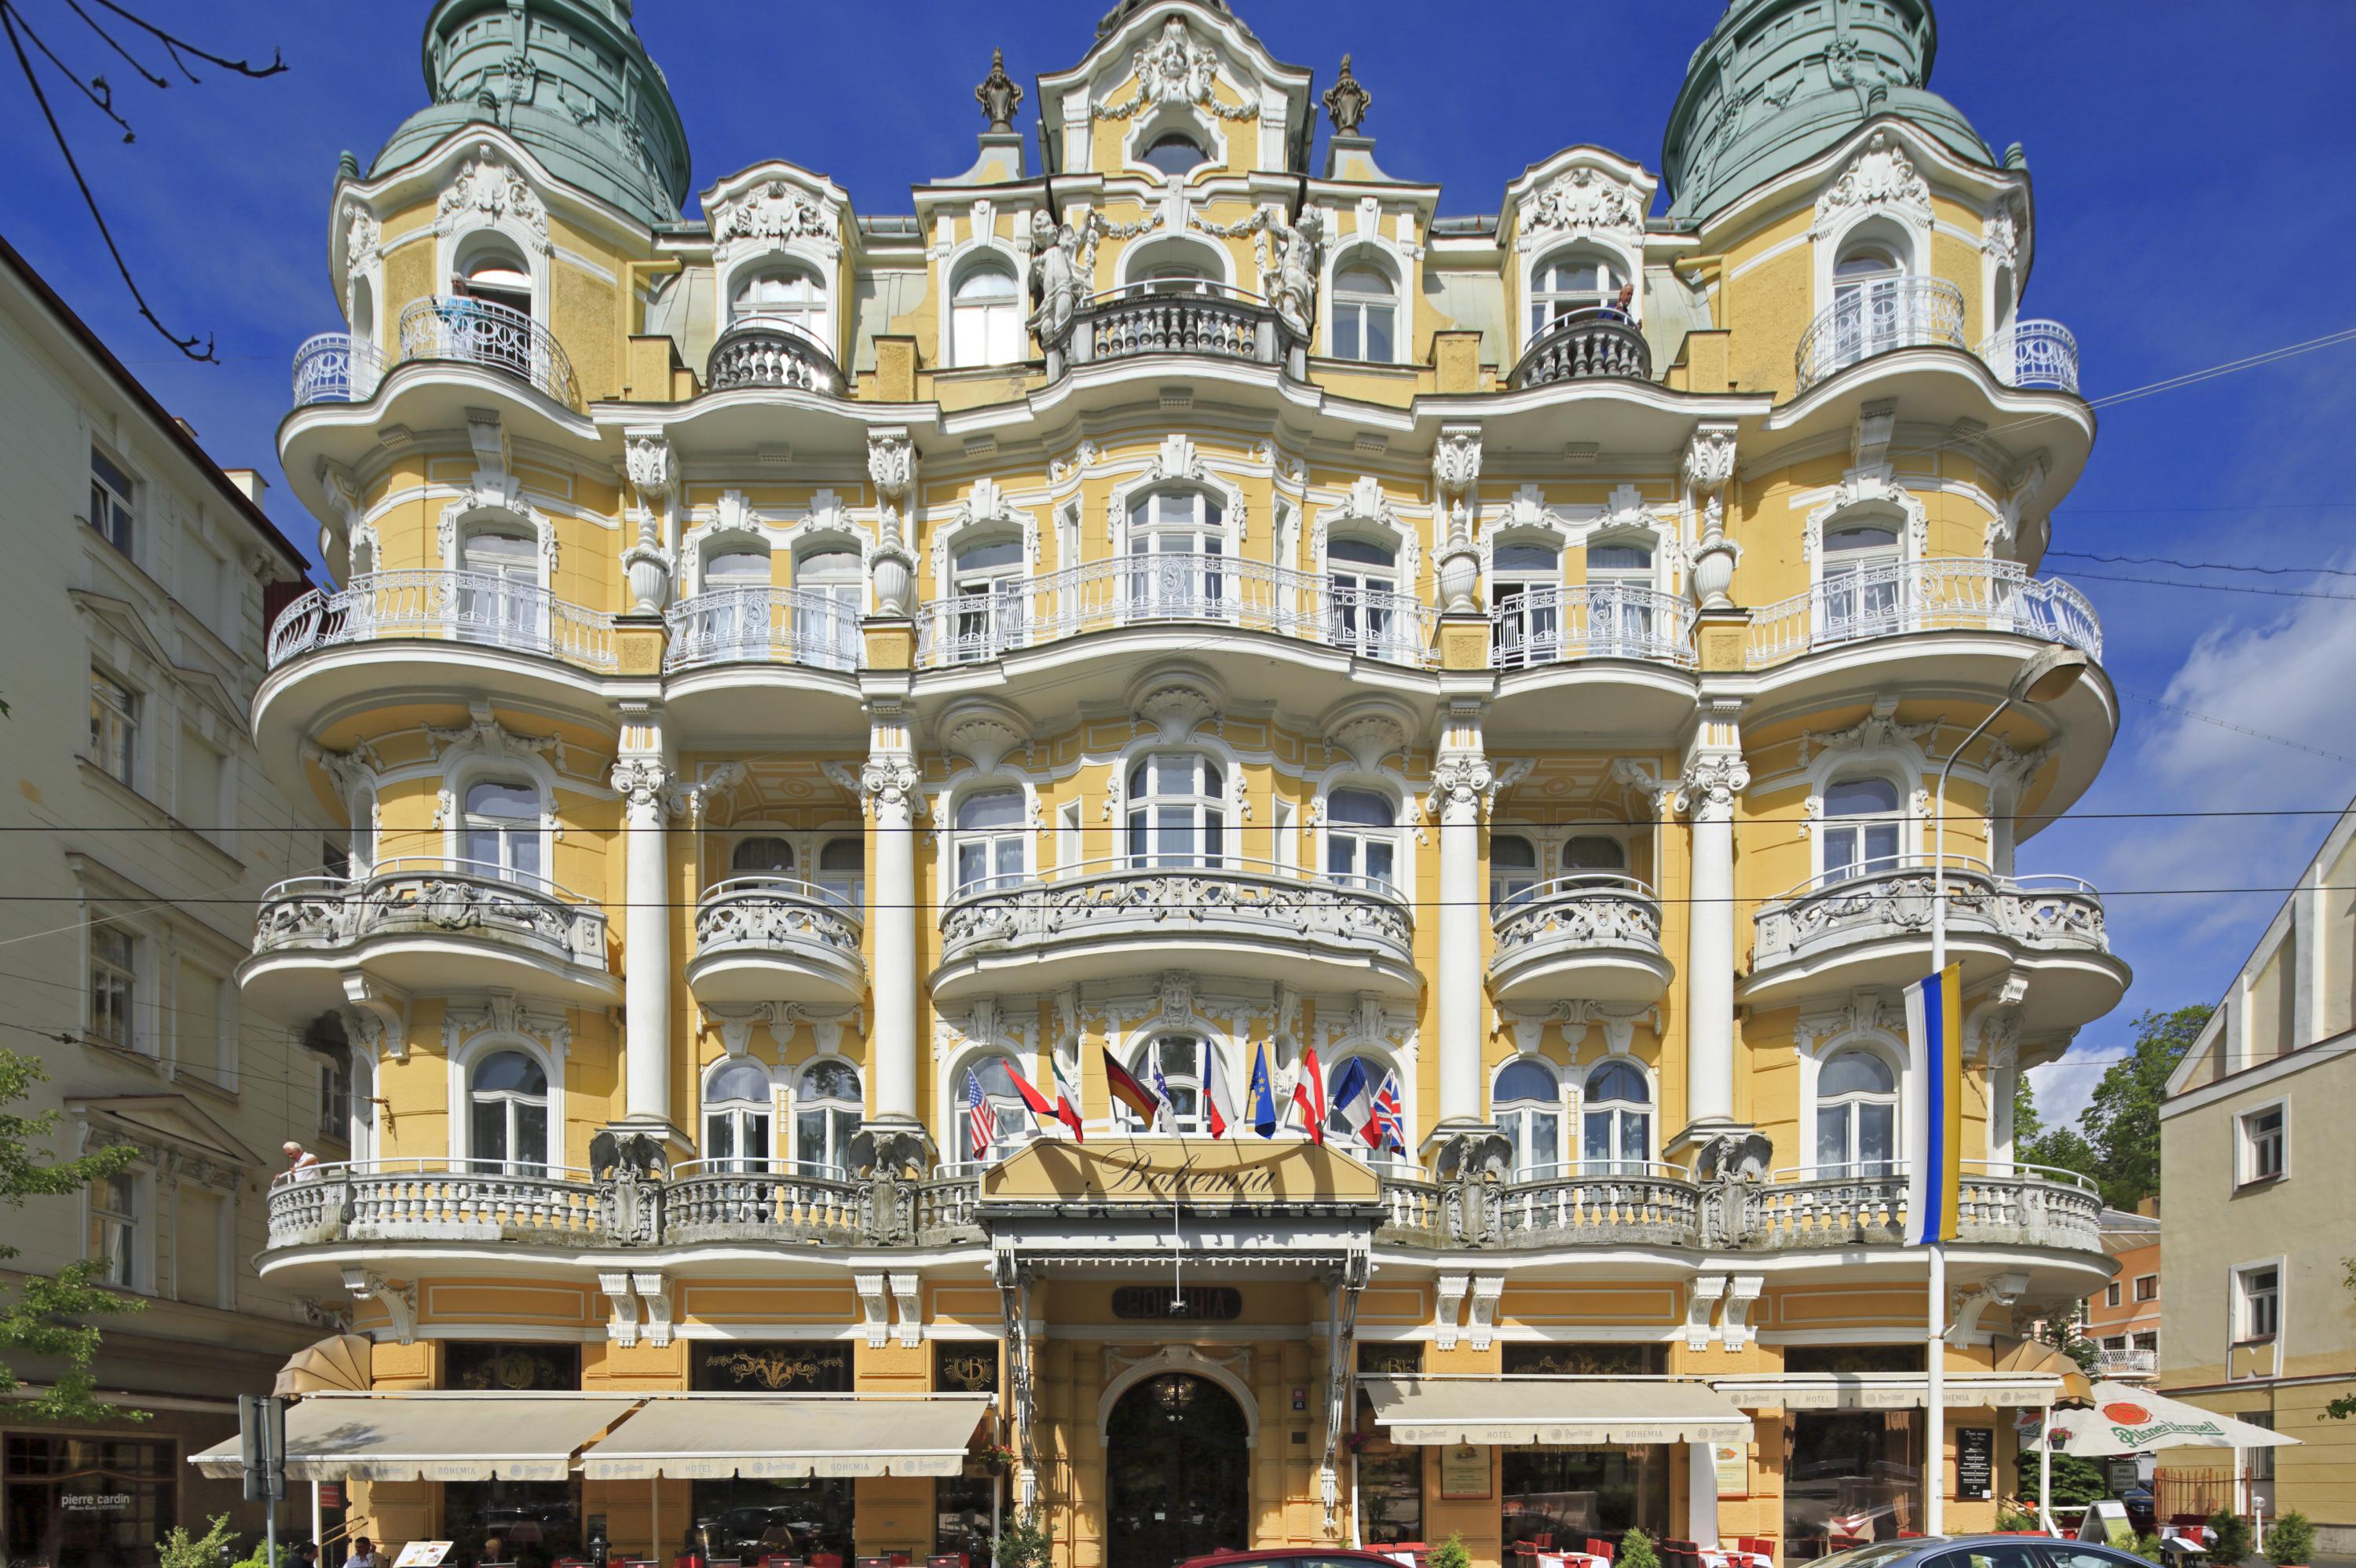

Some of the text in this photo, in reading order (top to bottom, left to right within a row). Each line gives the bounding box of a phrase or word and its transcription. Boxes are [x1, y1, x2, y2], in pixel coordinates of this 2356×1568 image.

[1085, 1147, 1278, 1193] Bohemia
[2110, 1420, 2222, 1449] Pilsner Urquell
[438, 1467, 476, 1475] BOHEMIA
[686, 1464, 713, 1473] HOTEL
[831, 1463, 869, 1471] BOHEMIA
[62, 1493, 130, 1508] pierre cardin
